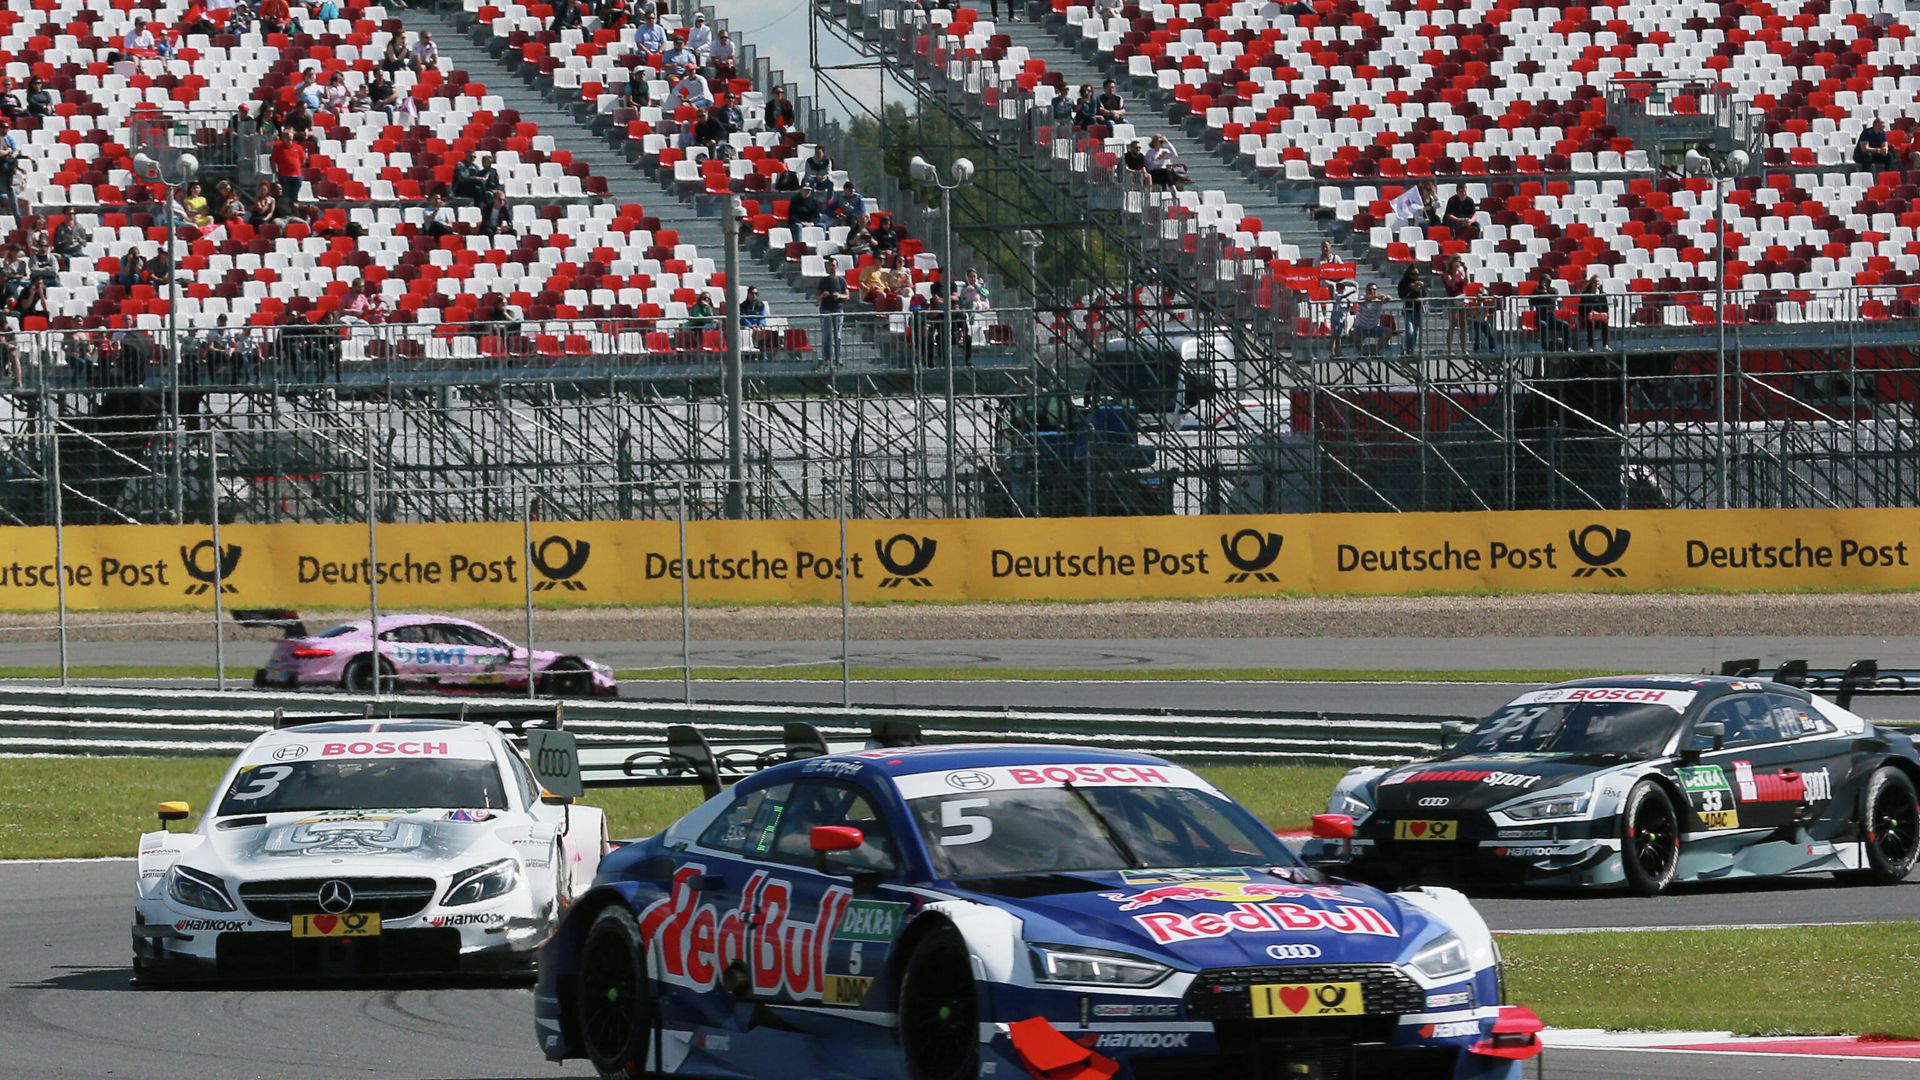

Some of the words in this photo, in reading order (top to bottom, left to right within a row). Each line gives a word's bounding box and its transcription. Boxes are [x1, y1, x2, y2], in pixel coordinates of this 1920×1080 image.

[645, 550, 788, 580] Deutsche
[796, 551, 864, 579] Post
[991, 546, 1136, 577] Deutsche
[1143, 547, 1210, 575] Post
[1337, 540, 1482, 572] Deutsche
[1490, 541, 1558, 570] Post
[1686, 538, 1833, 568] Deutsche
[1840, 538, 1909, 567] Post
[101, 557, 169, 586] Post
[298, 553, 442, 584] Deutsche
[449, 554, 518, 583] Post
[1568, 689, 1666, 701] BOSCH
[1476, 706, 1549, 735] 33
[322, 741, 448, 756] BOSCH
[232, 765, 294, 800] 3
[1007, 767, 1170, 785] BOSCH
[1684, 768, 1724, 787] DEKRA
[1702, 790, 1723, 812] 33
[939, 797, 993, 847] 5
[303, 916, 308, 935] I
[638, 861, 768, 994] Red
[752, 877, 853, 1001] Bull
[842, 906, 893, 935] DEKRA
[1133, 902, 1281, 944] Red
[1259, 902, 1401, 938] Bull
[848, 941, 863, 975] 5
[1136, 1004, 1179, 1016] EDGE
[1265, 987, 1273, 1015] I
